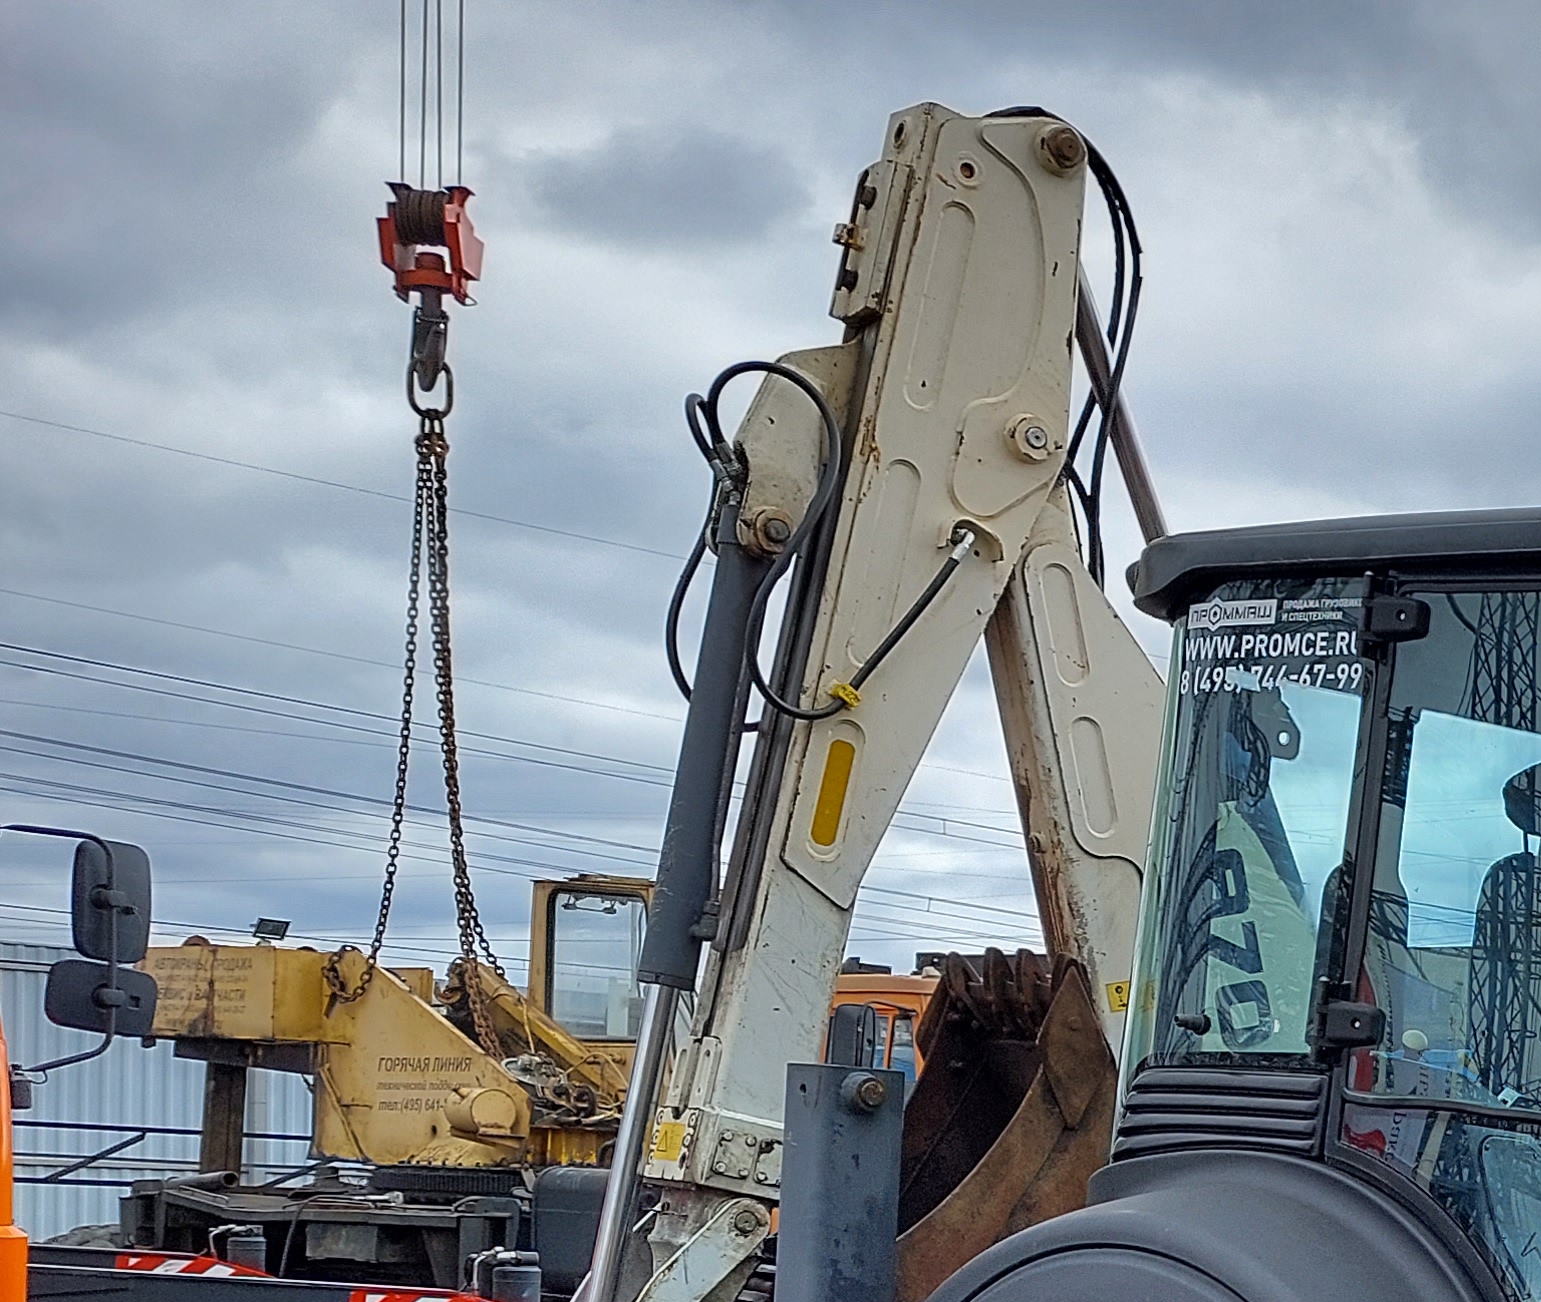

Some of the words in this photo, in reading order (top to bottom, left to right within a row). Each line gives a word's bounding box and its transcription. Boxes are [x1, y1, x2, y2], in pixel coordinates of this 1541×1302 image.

[1180, 670, 1190, 694] 8
[378, 1057, 431, 1072] ГОРЯЧАЯ
[432, 1057, 472, 1072] ЛИНИЯ
